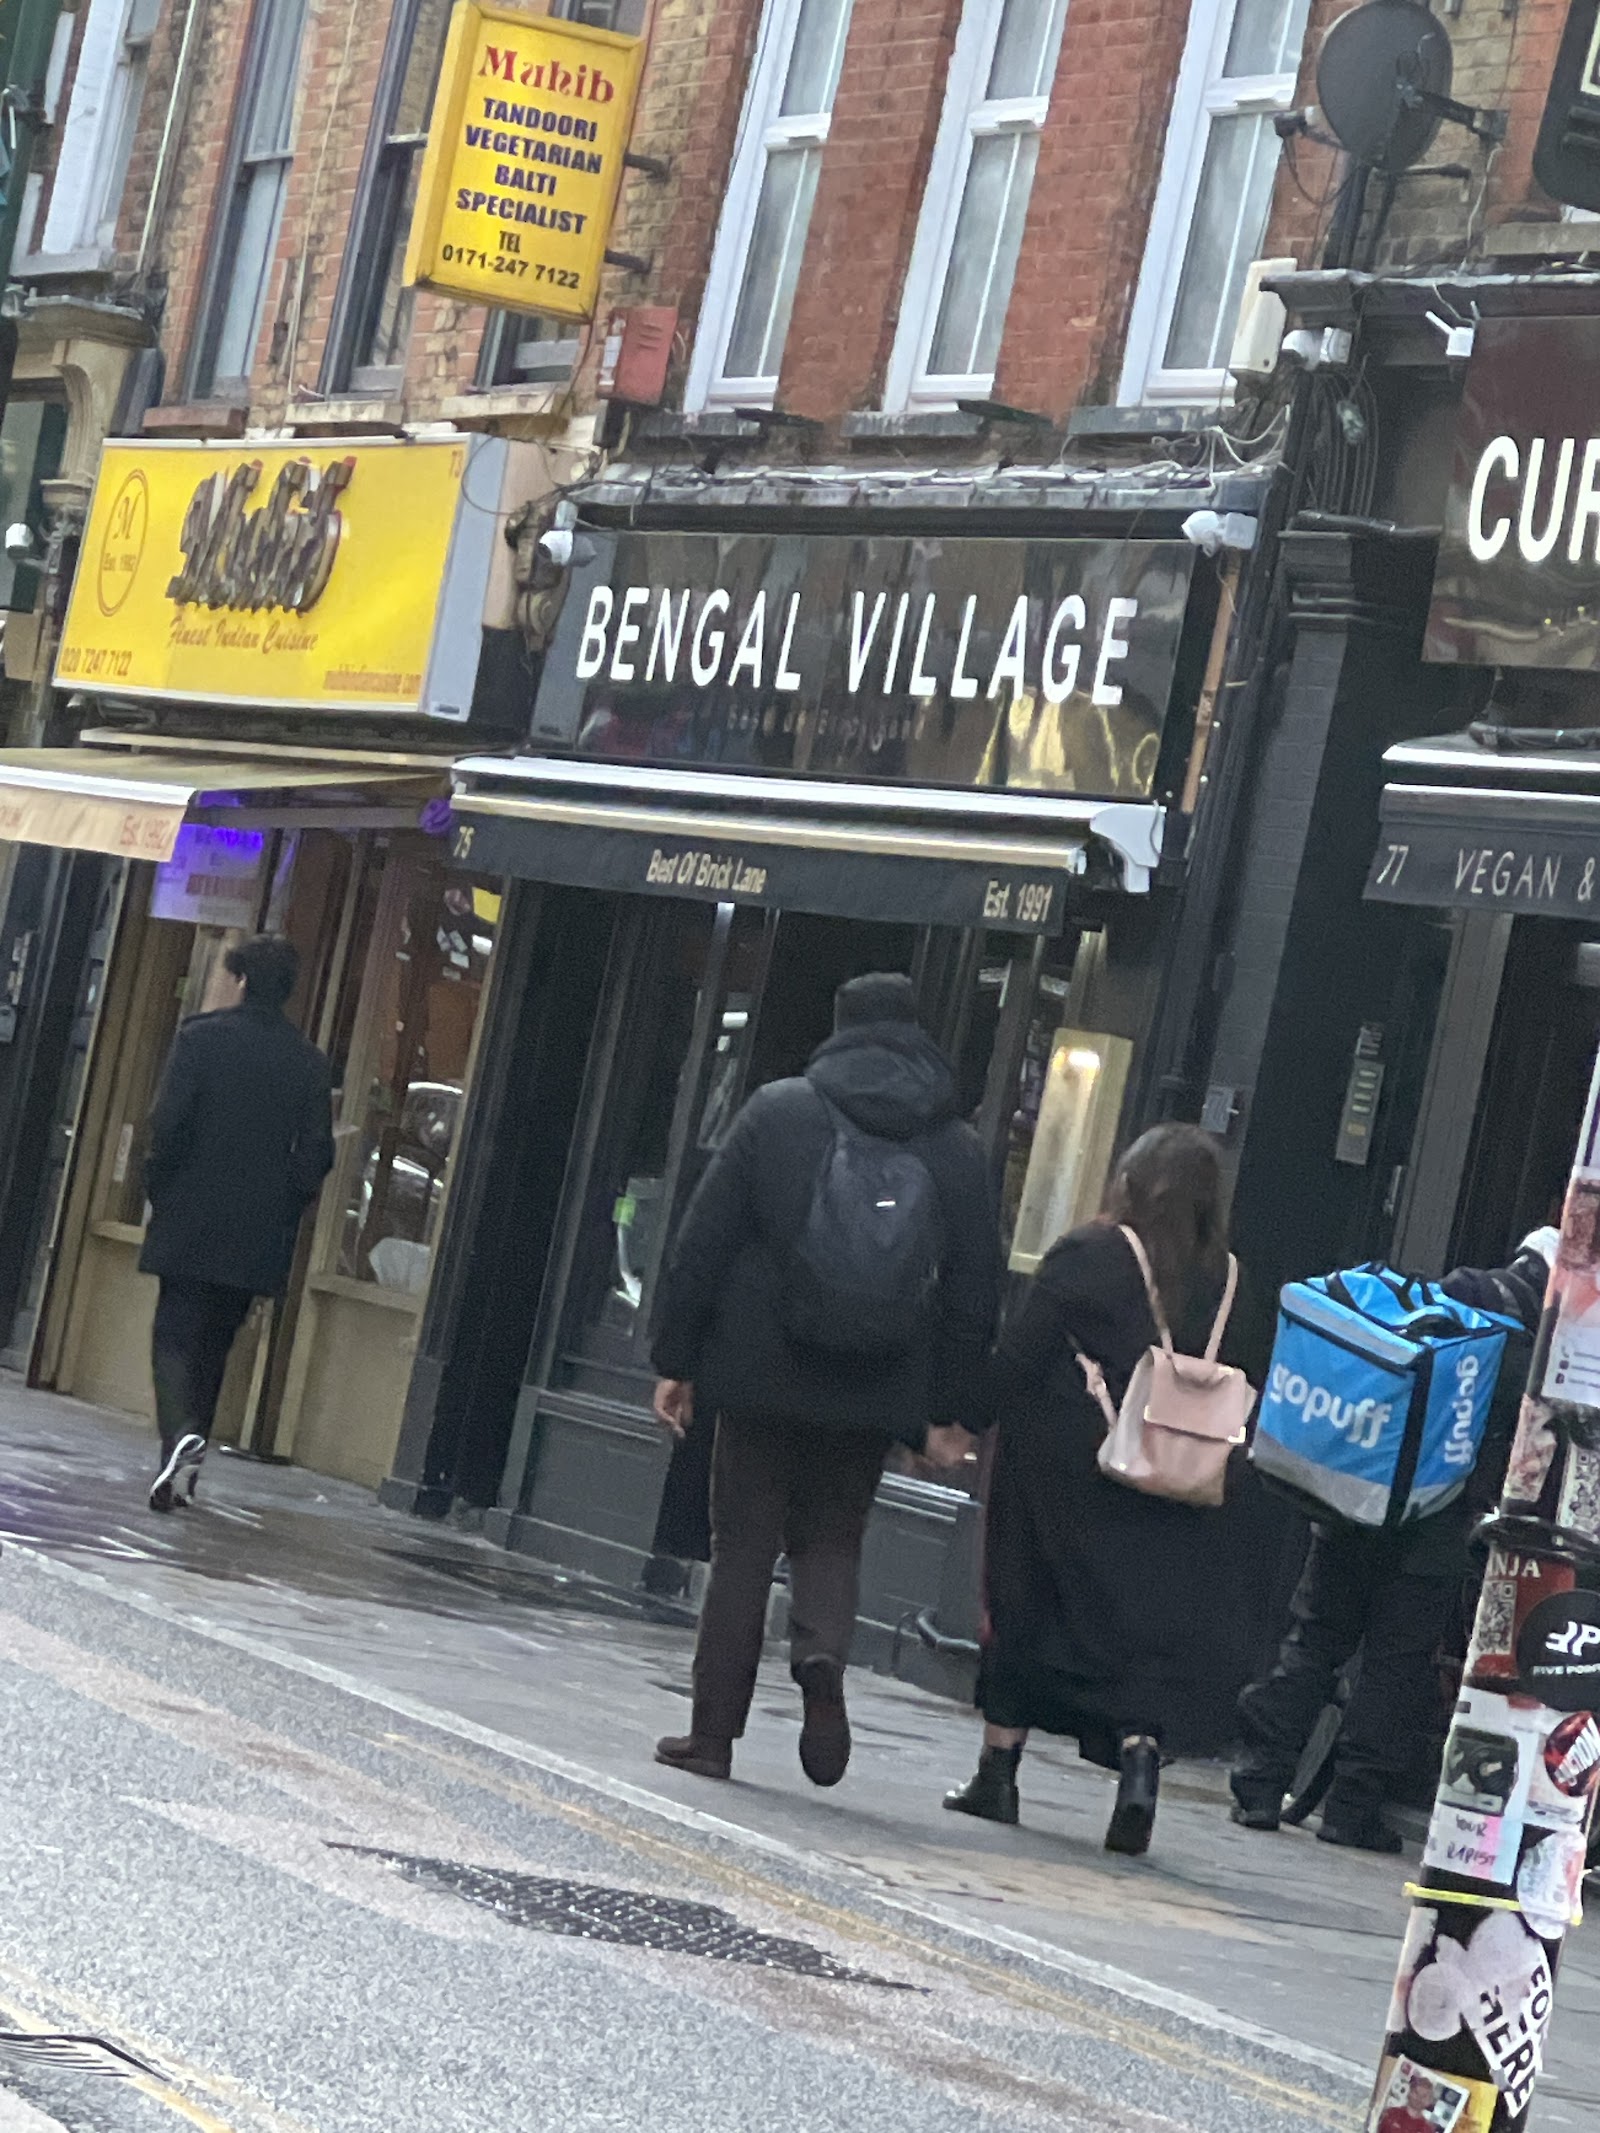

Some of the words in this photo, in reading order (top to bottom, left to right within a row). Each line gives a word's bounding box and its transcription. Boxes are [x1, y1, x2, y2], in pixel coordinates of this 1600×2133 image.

[478, 45, 615, 104] Muhib
[483, 97, 598, 142] TANDOORI
[465, 124, 603, 174] VEGETARIAN
[494, 164, 558, 197] BALTI
[456, 188, 588, 235] SPECIALIST
[498, 230, 522, 254] TEL
[442, 244, 530, 276] 0171-247
[535, 265, 581, 290] 7122
[167, 614, 213, 649] Finest
[214, 617, 260, 649] Indian
[262, 618, 319, 655] Cuisine
[576, 585, 802, 691] BENGAL
[848, 591, 1138, 705] VILLAGE
[453, 825, 475, 859] 75
[646, 848, 680, 884] Best
[677, 851, 701, 885] Of
[694, 853, 734, 890] Brick
[731, 857, 768, 894] Lane
[1376, 844, 1410, 887] 77
[1454, 848, 1563, 899] VEGAN
[1577, 856, 1597, 902] &
[1015, 882, 1054, 922] 1991
[1268, 1362, 1393, 1449] gopuff
[1443, 1355, 1480, 1466] gopuff
[1533, 1665, 1564, 1675] FIVE
